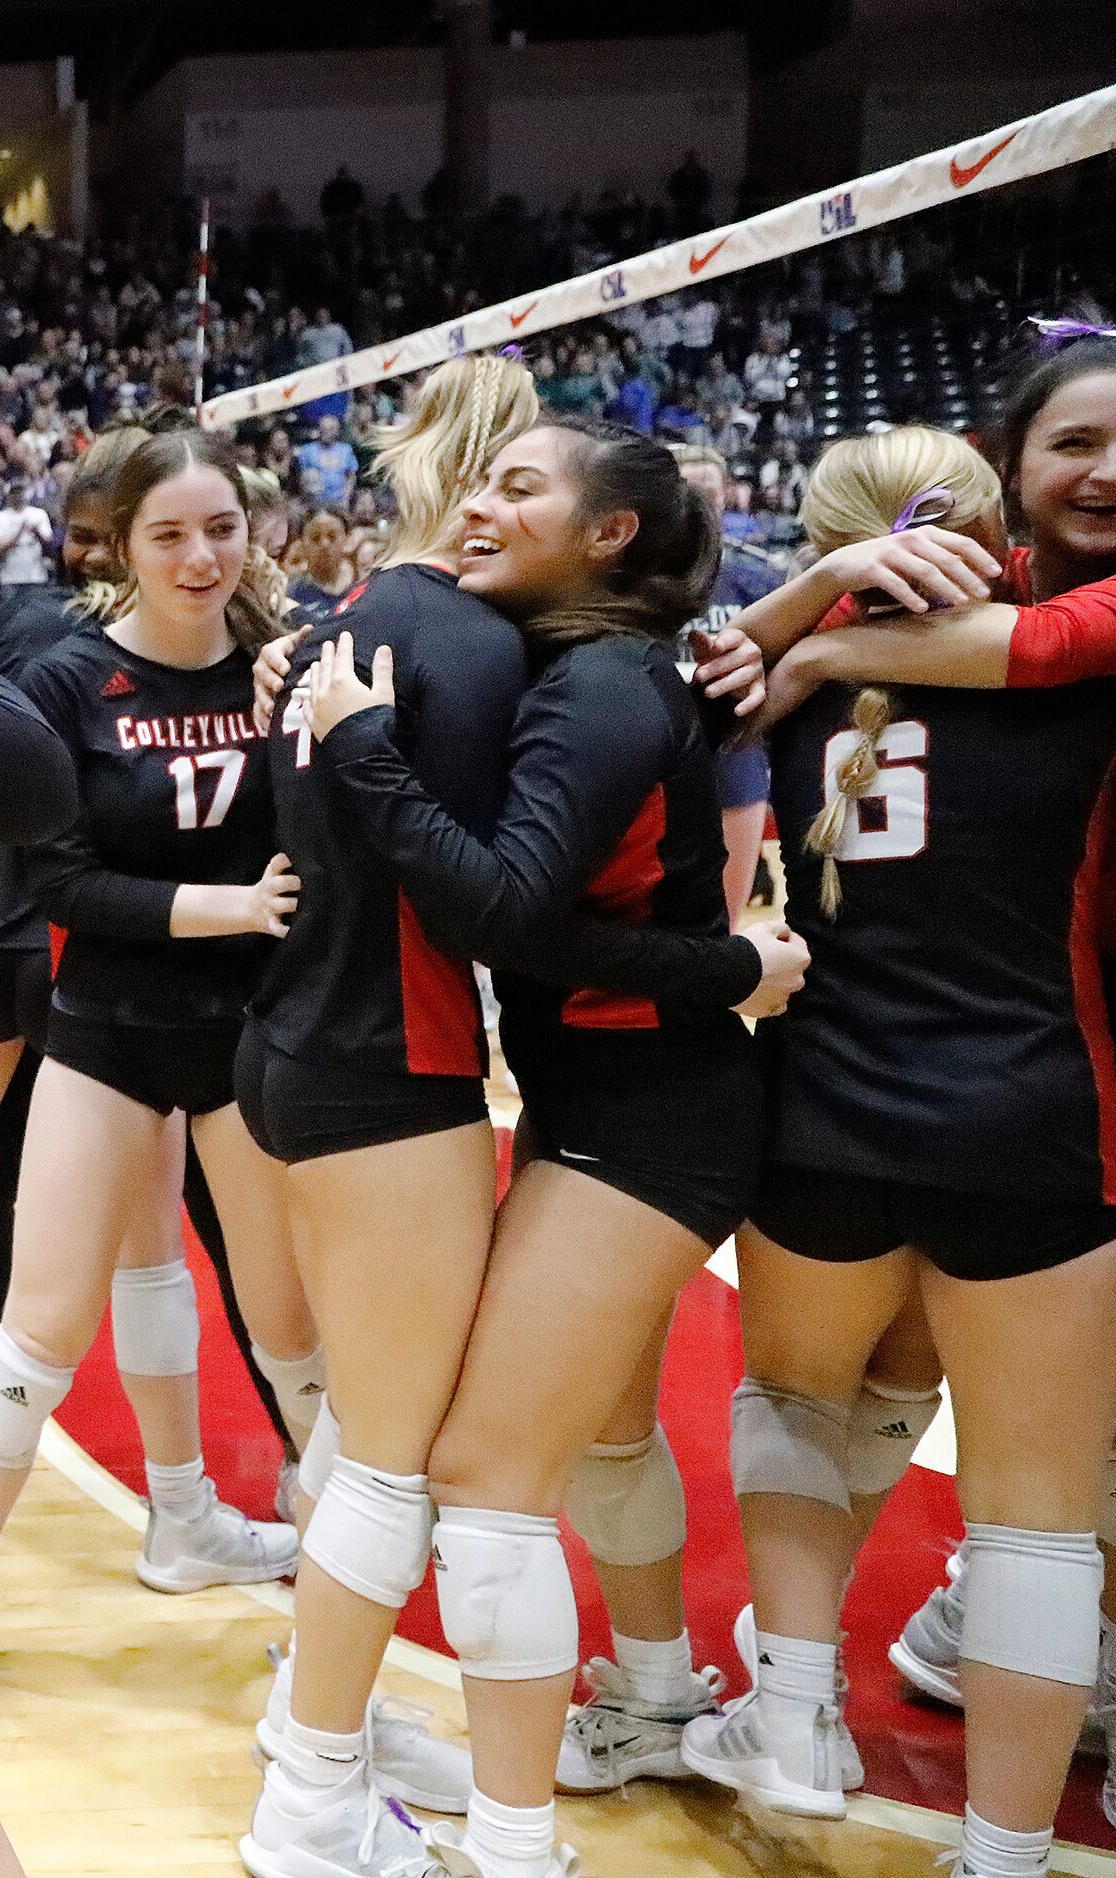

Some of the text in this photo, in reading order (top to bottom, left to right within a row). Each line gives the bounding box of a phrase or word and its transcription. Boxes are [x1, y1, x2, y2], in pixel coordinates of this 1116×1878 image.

[115, 712, 268, 751] COLLEYVIL
[167, 748, 248, 831] 17
[821, 718, 930, 865] 6
